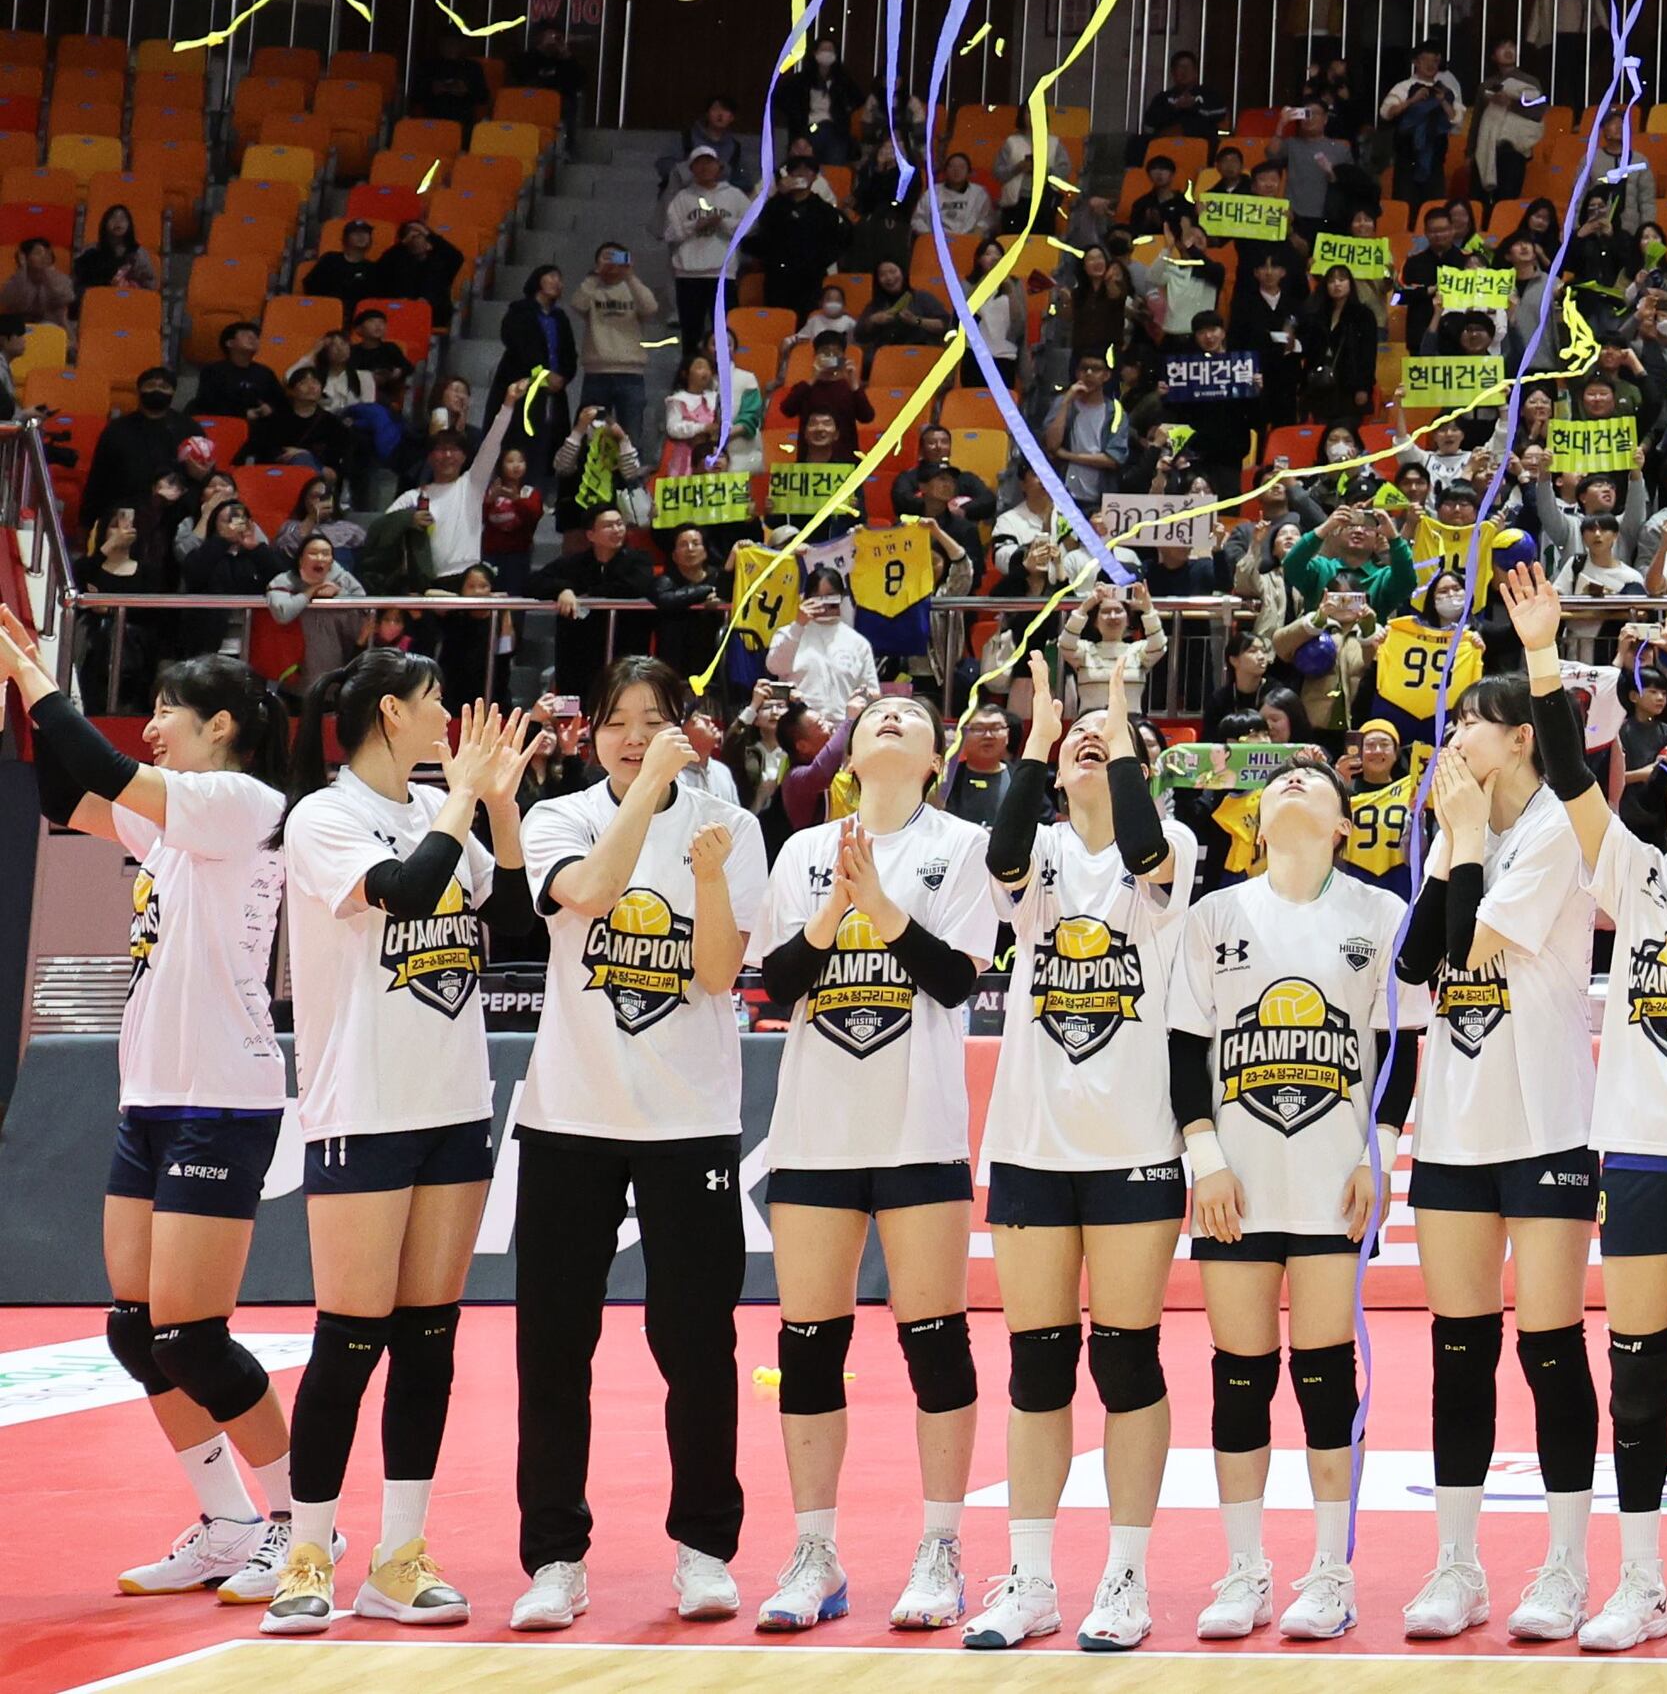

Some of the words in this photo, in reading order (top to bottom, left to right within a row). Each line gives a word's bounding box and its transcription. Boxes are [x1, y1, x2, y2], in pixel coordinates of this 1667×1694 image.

[1205, 200, 1285, 226] 현대건설
[1319, 240, 1386, 265] 현대건설
[1438, 273, 1515, 297] 현대건설
[1165, 357, 1255, 388] 현대건설
[1407, 364, 1504, 391] 현대건설
[1551, 428, 1633, 456] 현대건설
[661, 481, 751, 510] 현대건설
[884, 559, 906, 597] 8
[1403, 647, 1455, 689] 99
[1248, 752, 1282, 767] HILL
[1353, 806, 1405, 849] 99
[1339, 943, 1377, 959] HILLSTATE
[818, 990, 850, 1006] 23-24
[850, 988, 895, 1005] 정규리그
[1064, 994, 1105, 1010] 정규리그
[844, 1014, 883, 1028] HILLSTATE
[1222, 1033, 1361, 1070] CHAMPIONS
[1245, 1069, 1275, 1083] 23-24
[1276, 1068, 1320, 1082] 정규리그
[1320, 1068, 1336, 1084] 1위
[1272, 1092, 1307, 1107] HILLSTATE
[184, 1164, 228, 1181] 현대건설
[1146, 1165, 1181, 1181] 현대건설
[1557, 1171, 1590, 1187] 현대건설
